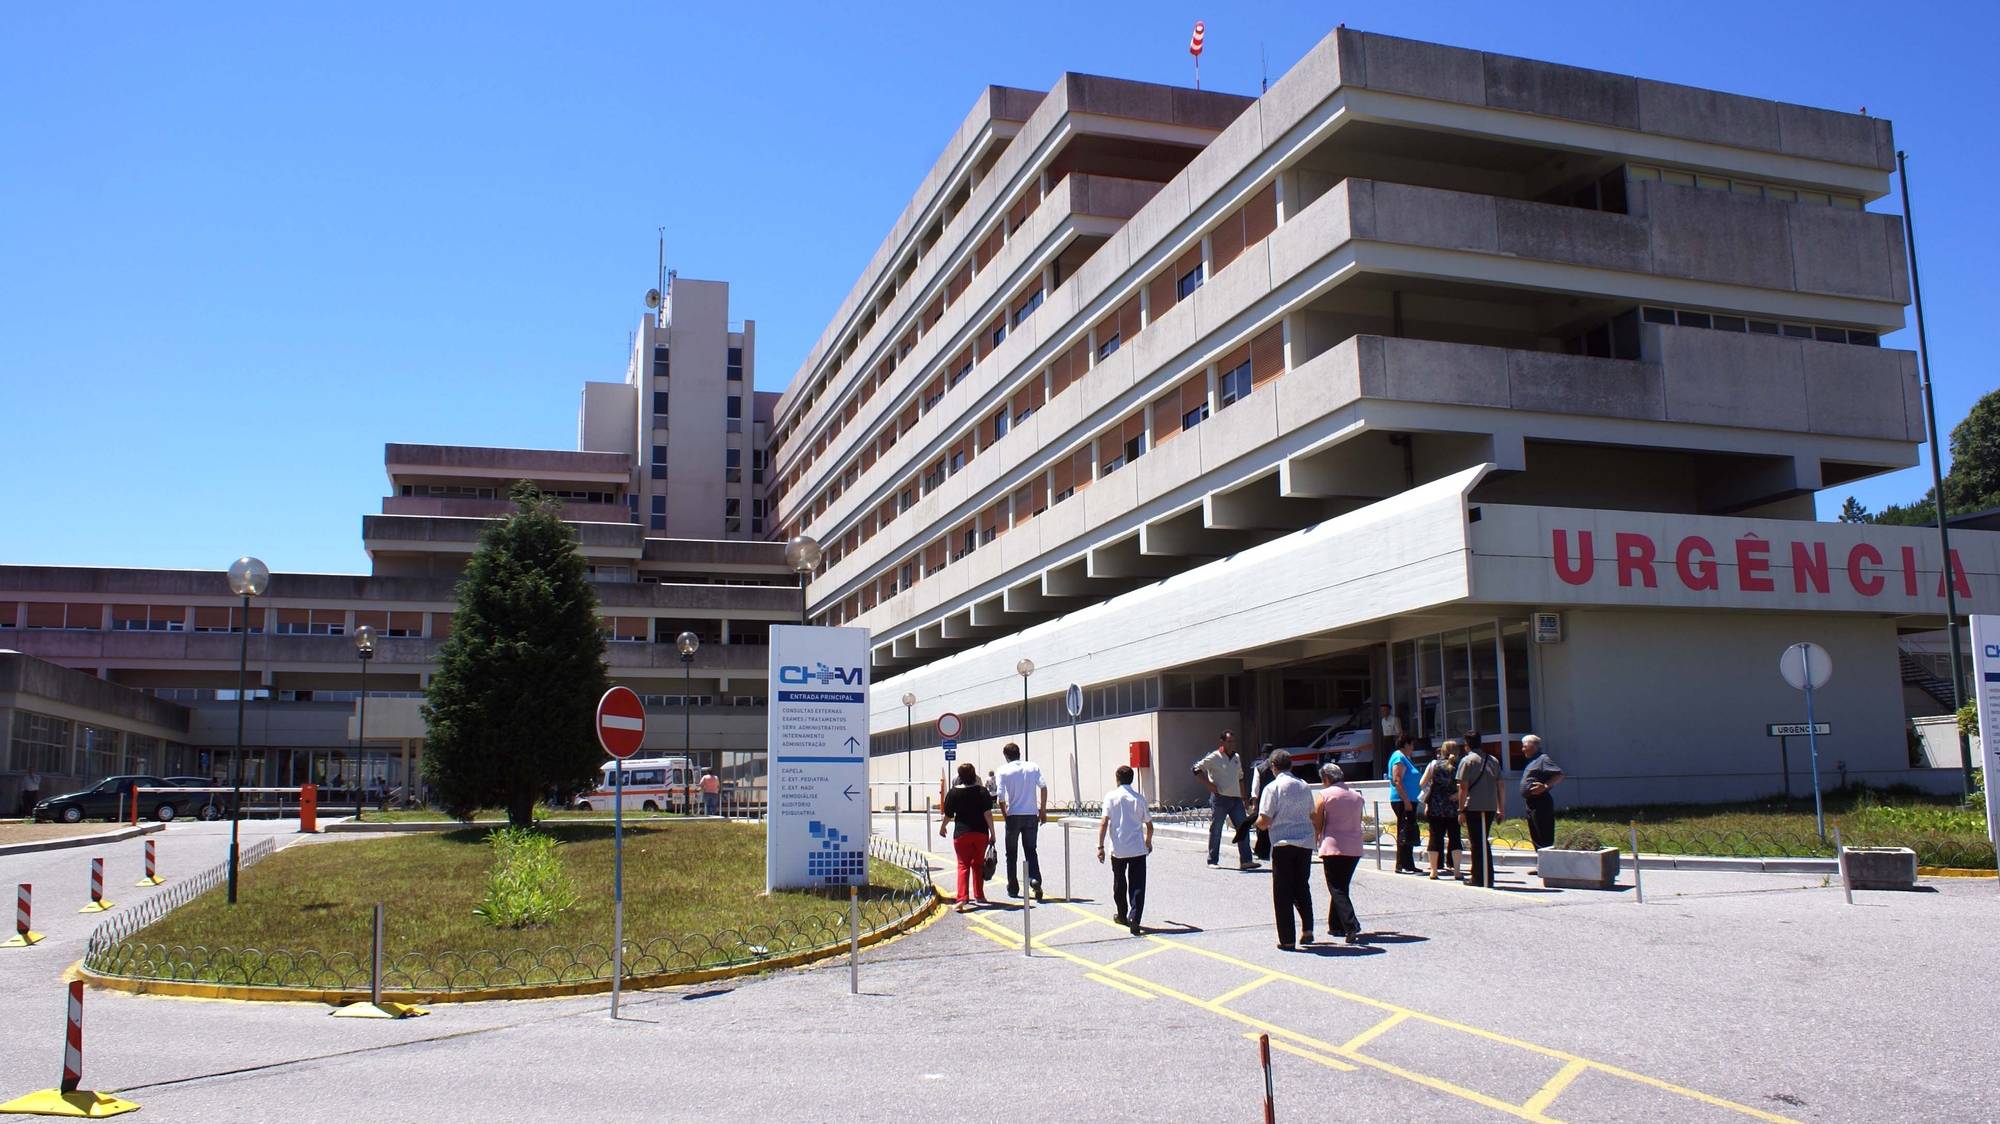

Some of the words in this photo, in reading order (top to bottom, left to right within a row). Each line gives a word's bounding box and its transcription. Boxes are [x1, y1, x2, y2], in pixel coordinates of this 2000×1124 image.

[1552, 530, 1973, 599] URGÊNCIA
[790, 693, 819, 701] ENTRADA
[820, 693, 854, 701] PRINCIPAL
